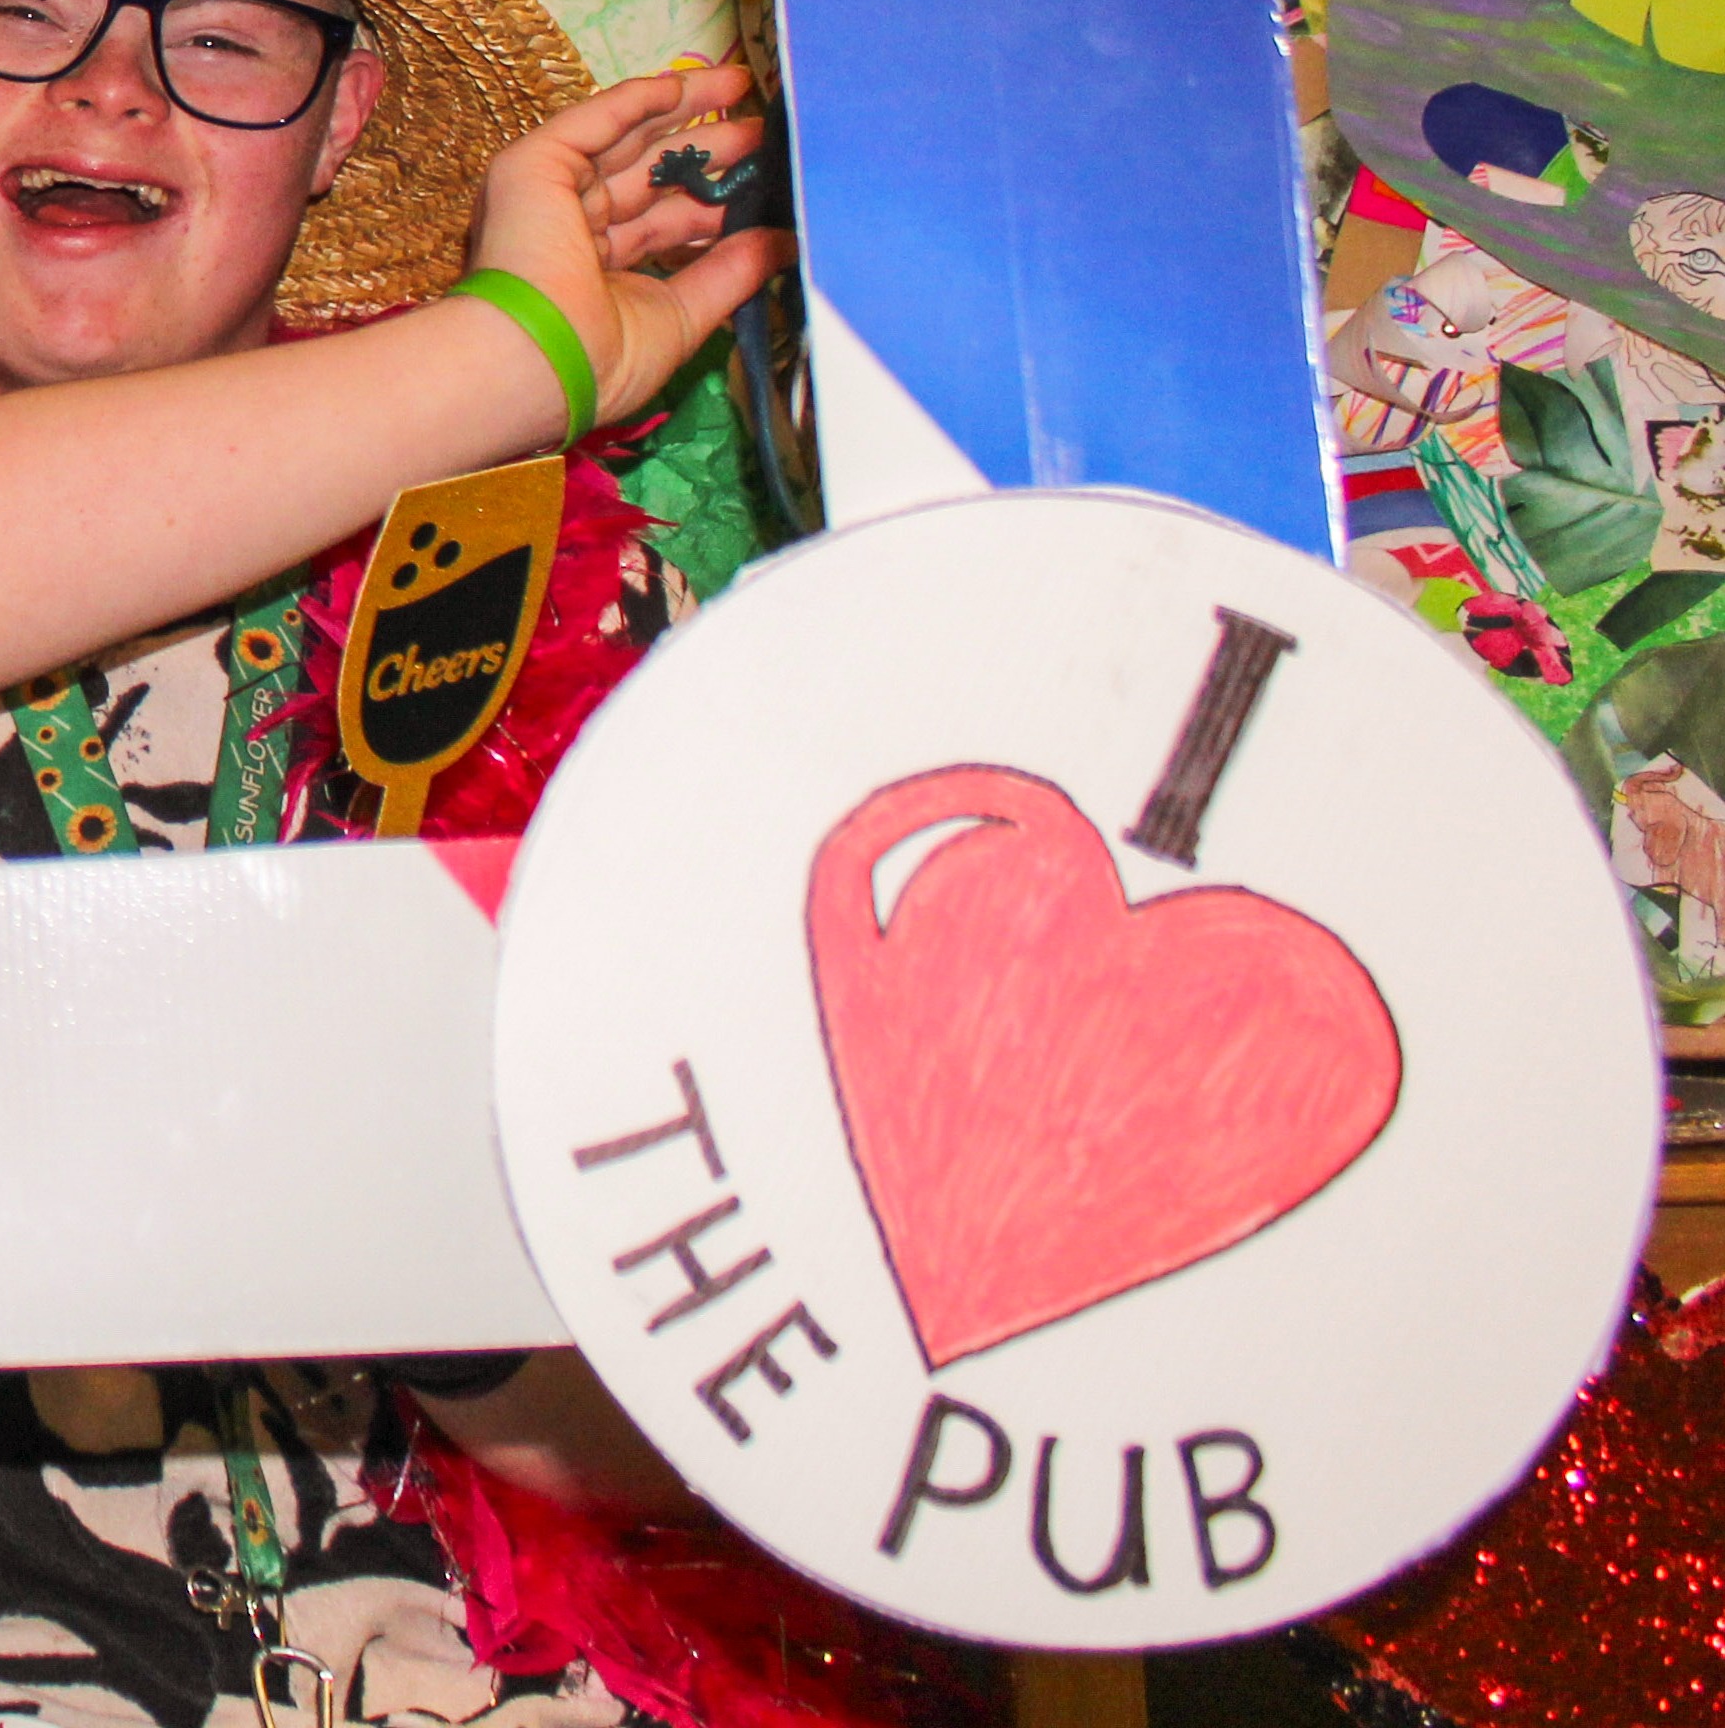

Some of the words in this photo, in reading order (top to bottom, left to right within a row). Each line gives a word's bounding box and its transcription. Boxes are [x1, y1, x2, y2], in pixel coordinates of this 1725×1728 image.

[234, 686, 276, 845] SUNFLOER
[367, 640, 508, 703] Cheers
[1123, 604, 1297, 870] I
[571, 1057, 839, 1446] THE
[878, 1391, 1278, 1597] PUB
